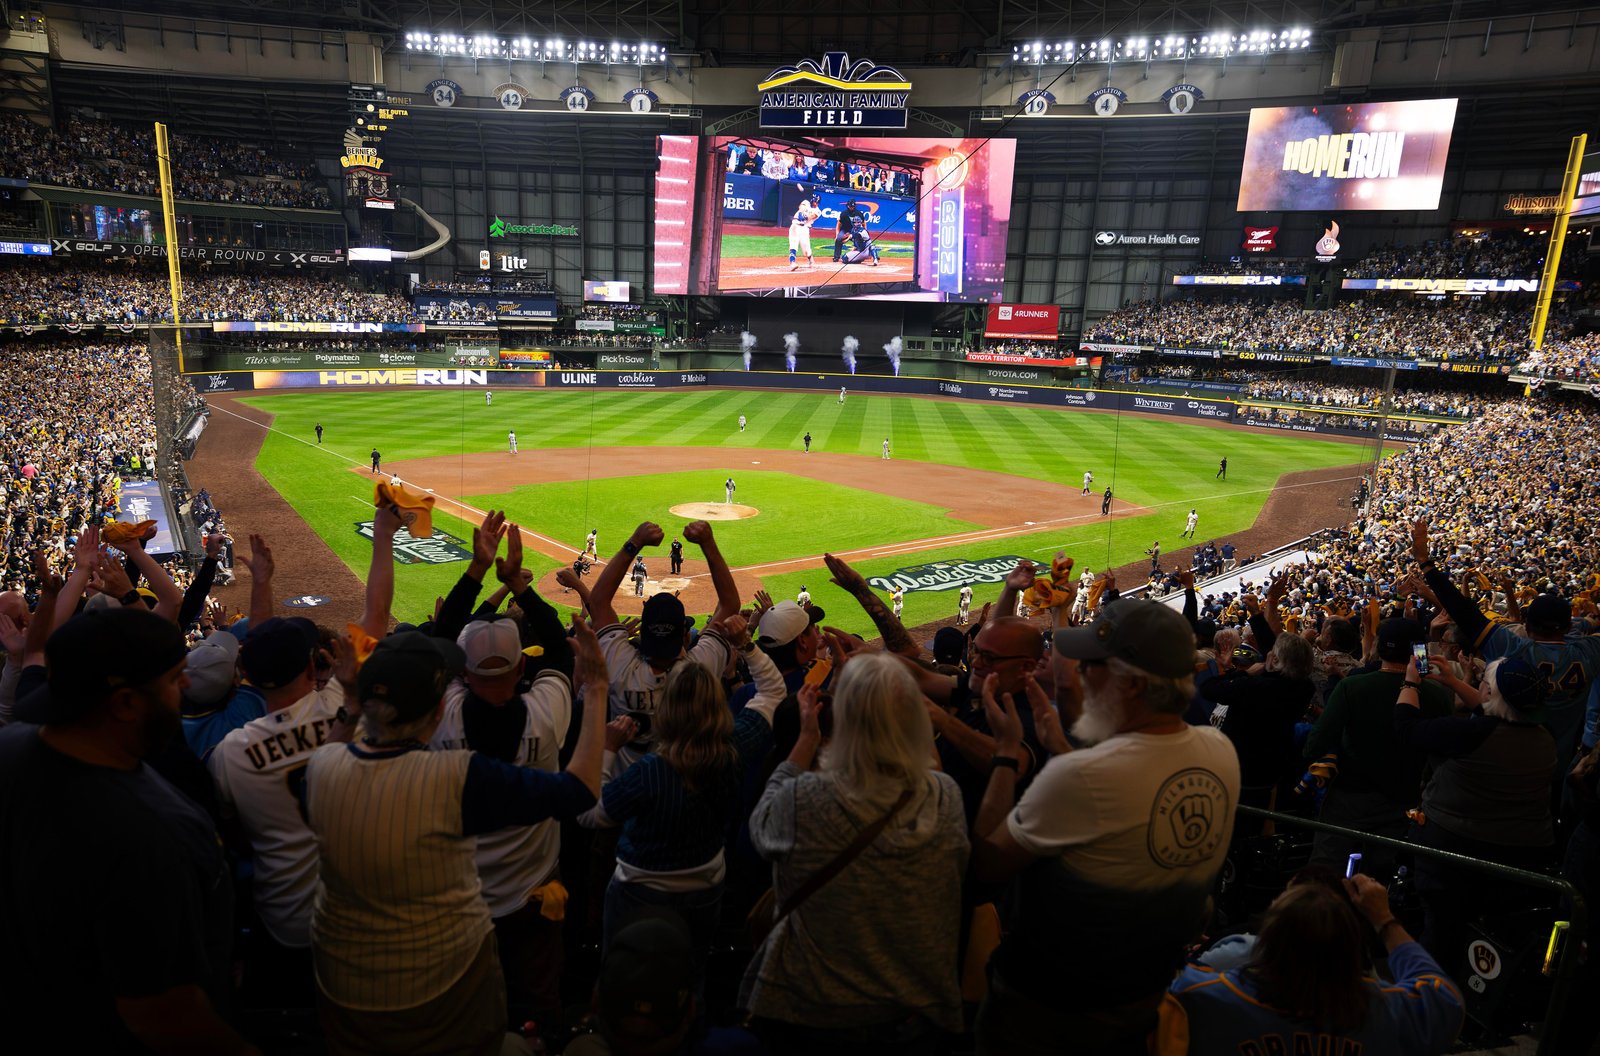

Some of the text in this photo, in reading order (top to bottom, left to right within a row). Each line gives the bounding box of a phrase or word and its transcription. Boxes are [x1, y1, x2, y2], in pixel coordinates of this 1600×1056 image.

[431, 80, 456, 88] FINGERS
[1170, 85, 1196, 94] UECKER
[436, 89, 453, 103] 34
[1093, 88, 1122, 97] MOLITOR
[503, 93, 519, 107] 42
[569, 96, 585, 109] 44
[637, 99, 646, 112] 1
[761, 92, 909, 108] AMERICAN FAMILY
[1100, 98, 1110, 112] 4
[1029, 99, 1044, 114] 19
[803, 110, 863, 125] FIELD
[346, 146, 378, 157] BERNIE'S
[340, 154, 384, 170] CHALET
[940, 200, 956, 275] RUN
[1116, 234, 1200, 245] Aurora Health Care
[75, 242, 112, 252] GOLF
[133, 245, 169, 257] OPEN
[214, 249, 266, 261] ROUND
[310, 255, 345, 263] GOLF
[501, 255, 528, 272] Lite
[1376, 278, 1538, 292] HOMERUN
[1014, 310, 1049, 318] 4RUNNER
[254, 321, 383, 333] HOMERUN
[455, 347, 490, 356] Johnsonville
[1239, 352, 1282, 361] 620 WTMJ
[245, 355, 269, 365] Tito's
[315, 354, 360, 362] Polymatech
[389, 354, 416, 362] clover
[625, 355, 645, 363] Save
[992, 355, 1027, 363] TERRITORY
[987, 369, 1038, 379] TOYOTA.COM
[1451, 363, 1499, 374] NICOLET LAW
[319, 369, 488, 385] HOMERUN
[561, 373, 597, 384] ULINE
[618, 372, 656, 383] carbliss
[1134, 397, 1175, 409] WINTRUST
[1197, 408, 1216, 416] Health
[869, 564, 964, 593] World
